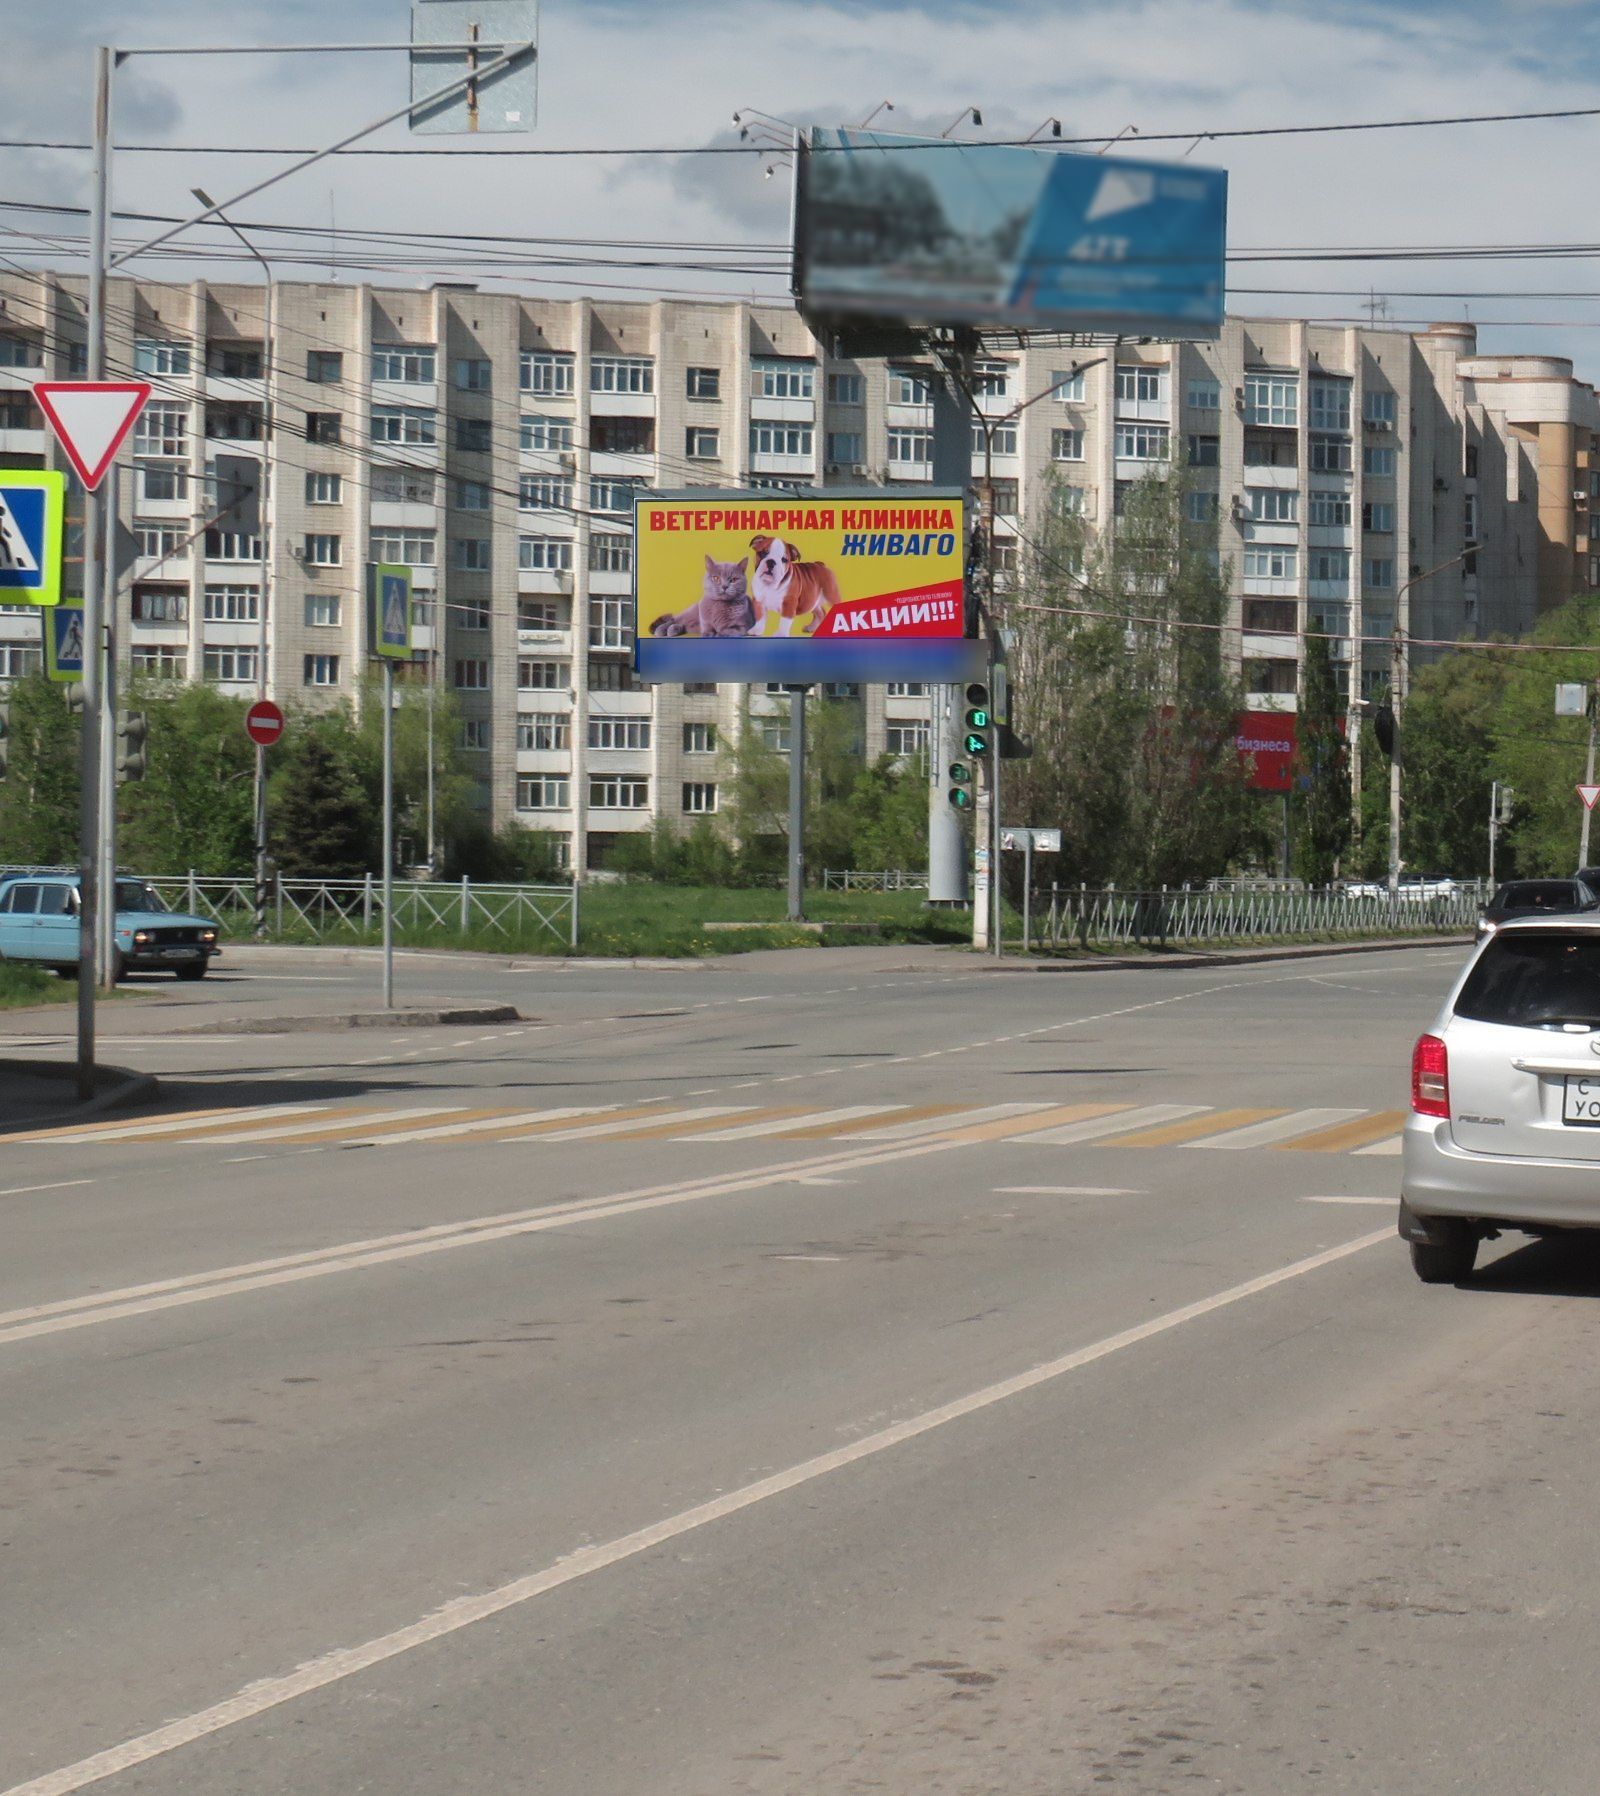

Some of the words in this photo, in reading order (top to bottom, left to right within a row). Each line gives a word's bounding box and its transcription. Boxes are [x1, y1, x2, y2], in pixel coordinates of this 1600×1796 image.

[650, 509, 835, 532] ВЕТЕРИНАРНАЯ
[841, 509, 955, 530] КЛИНИКА
[840, 533, 955, 556] ЖИВАГО
[1237, 736, 1290, 752] бизнеса
